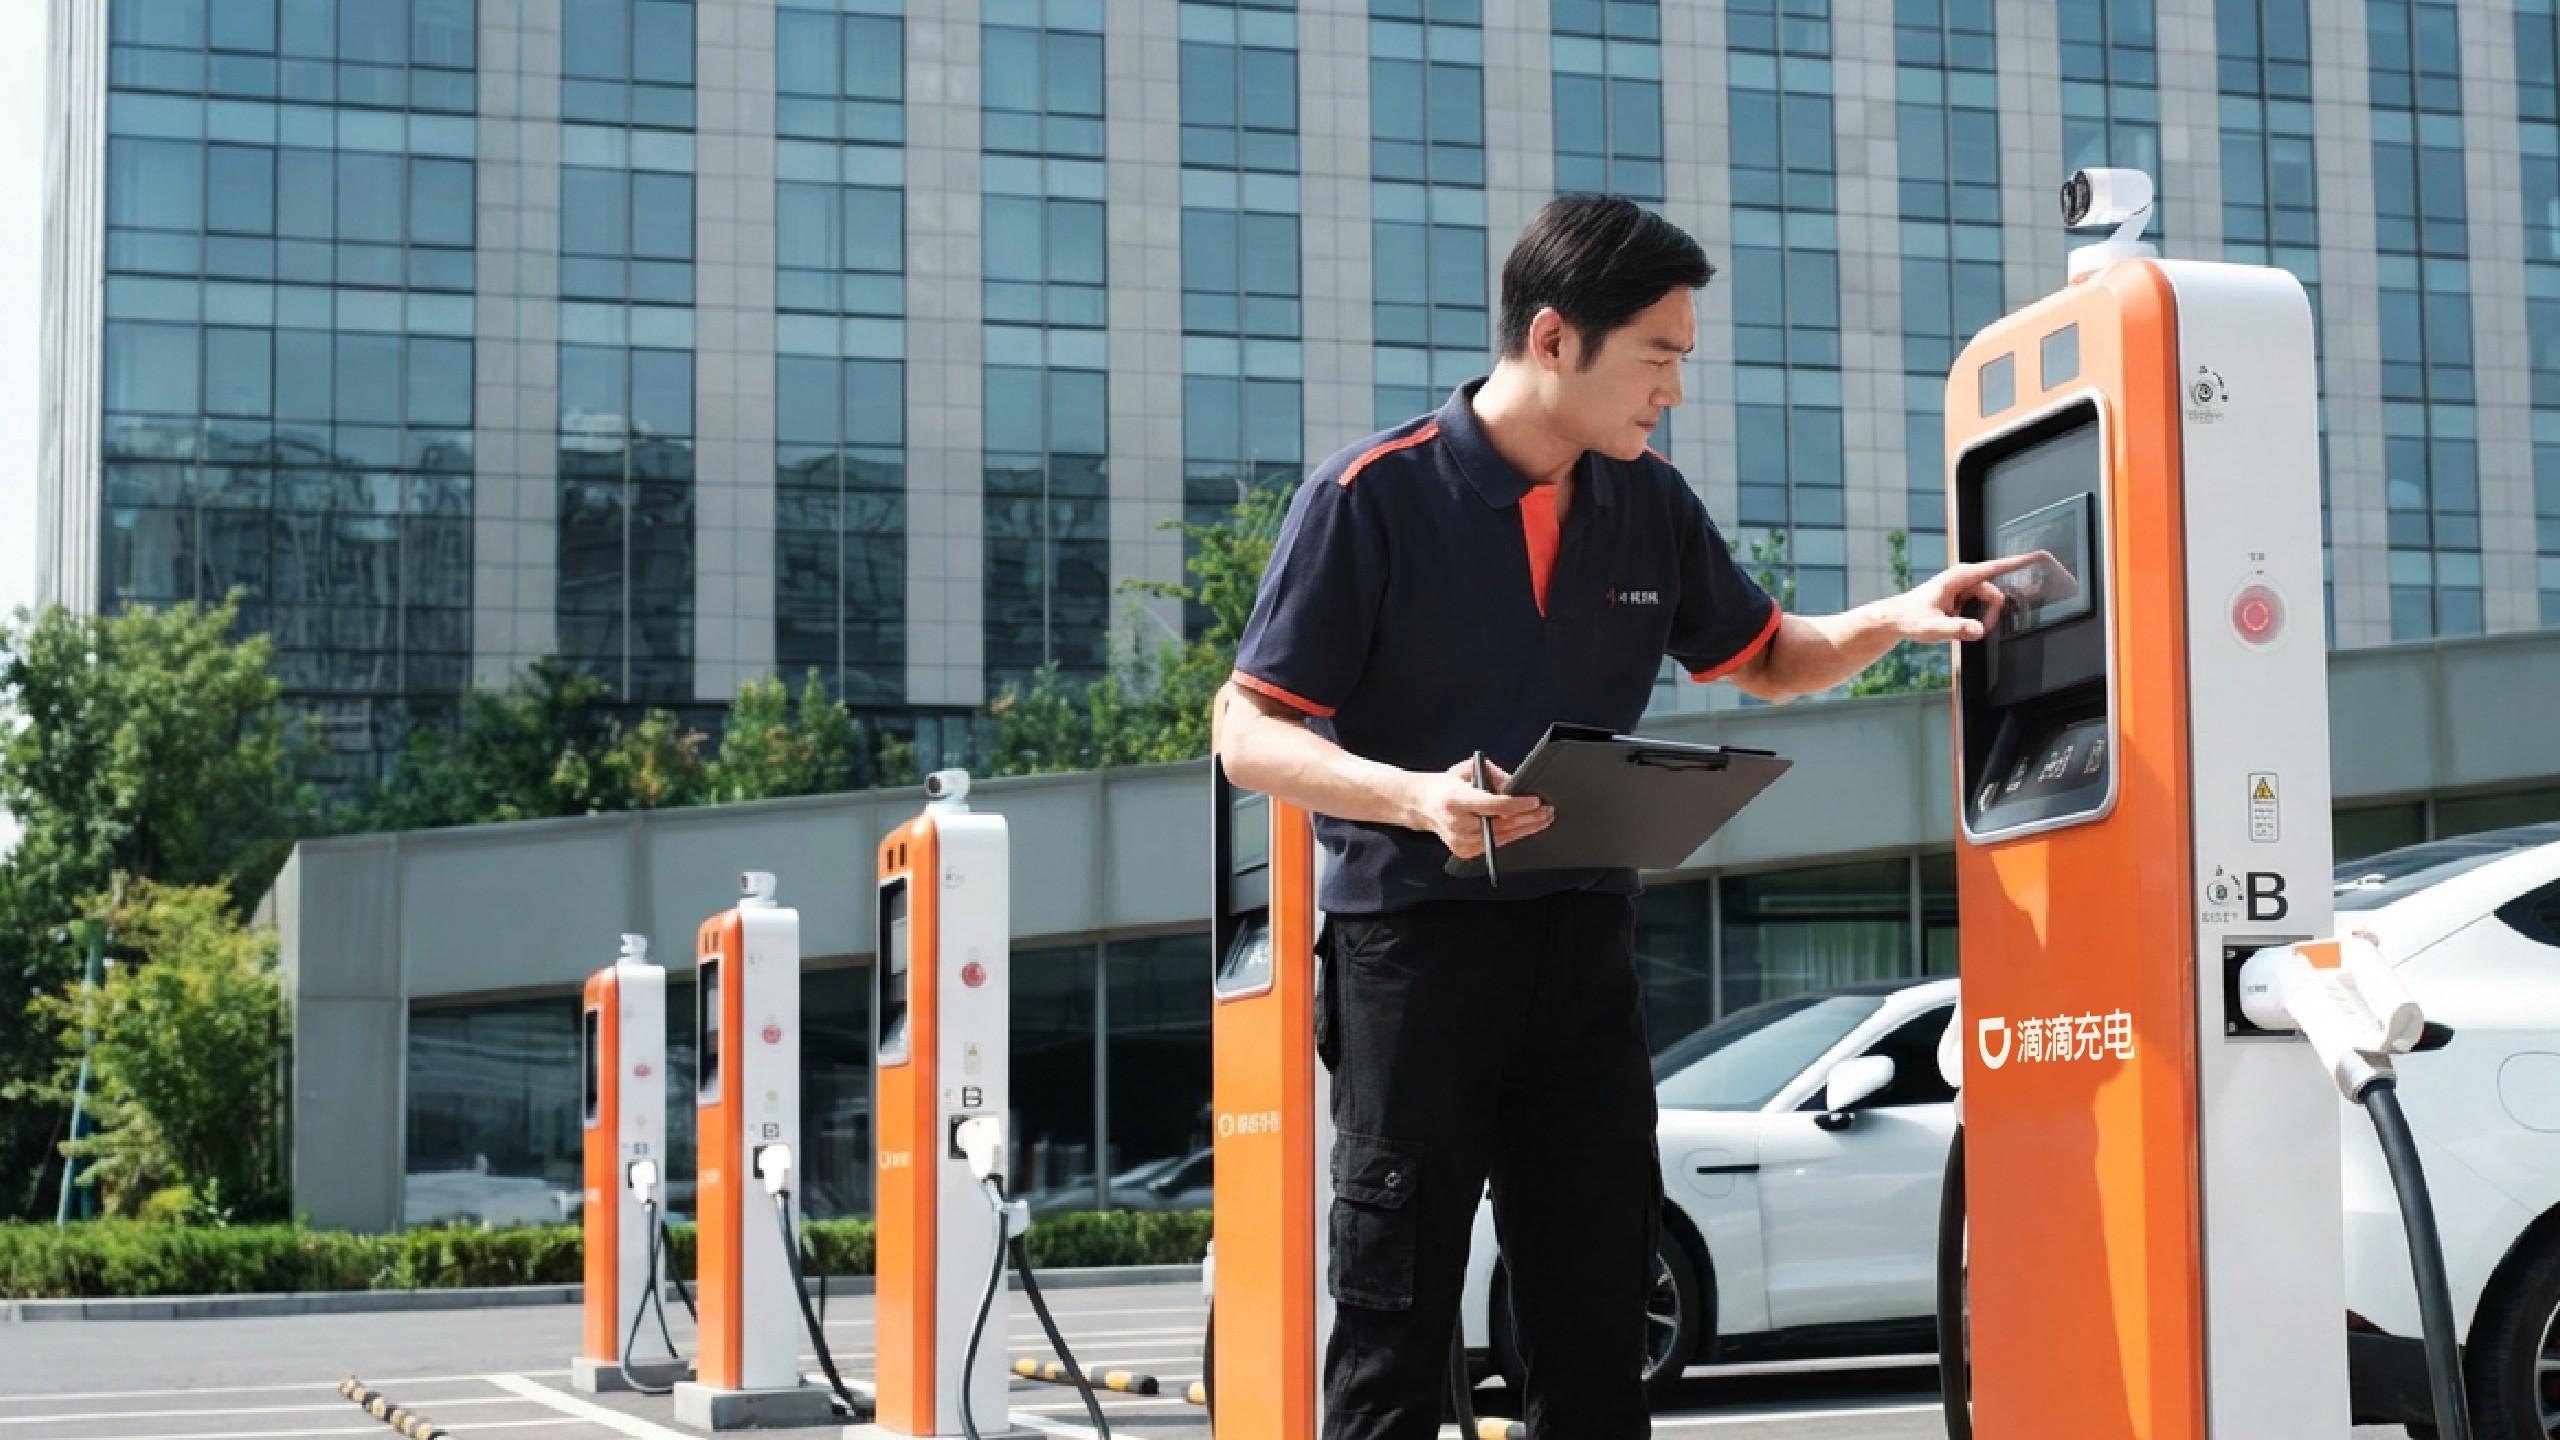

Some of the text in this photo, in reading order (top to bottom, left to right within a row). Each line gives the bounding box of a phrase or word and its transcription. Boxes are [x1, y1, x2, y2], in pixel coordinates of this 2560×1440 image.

[2247, 872, 2288, 921] B
[2017, 1008, 2134, 1063] 滴滴充电
